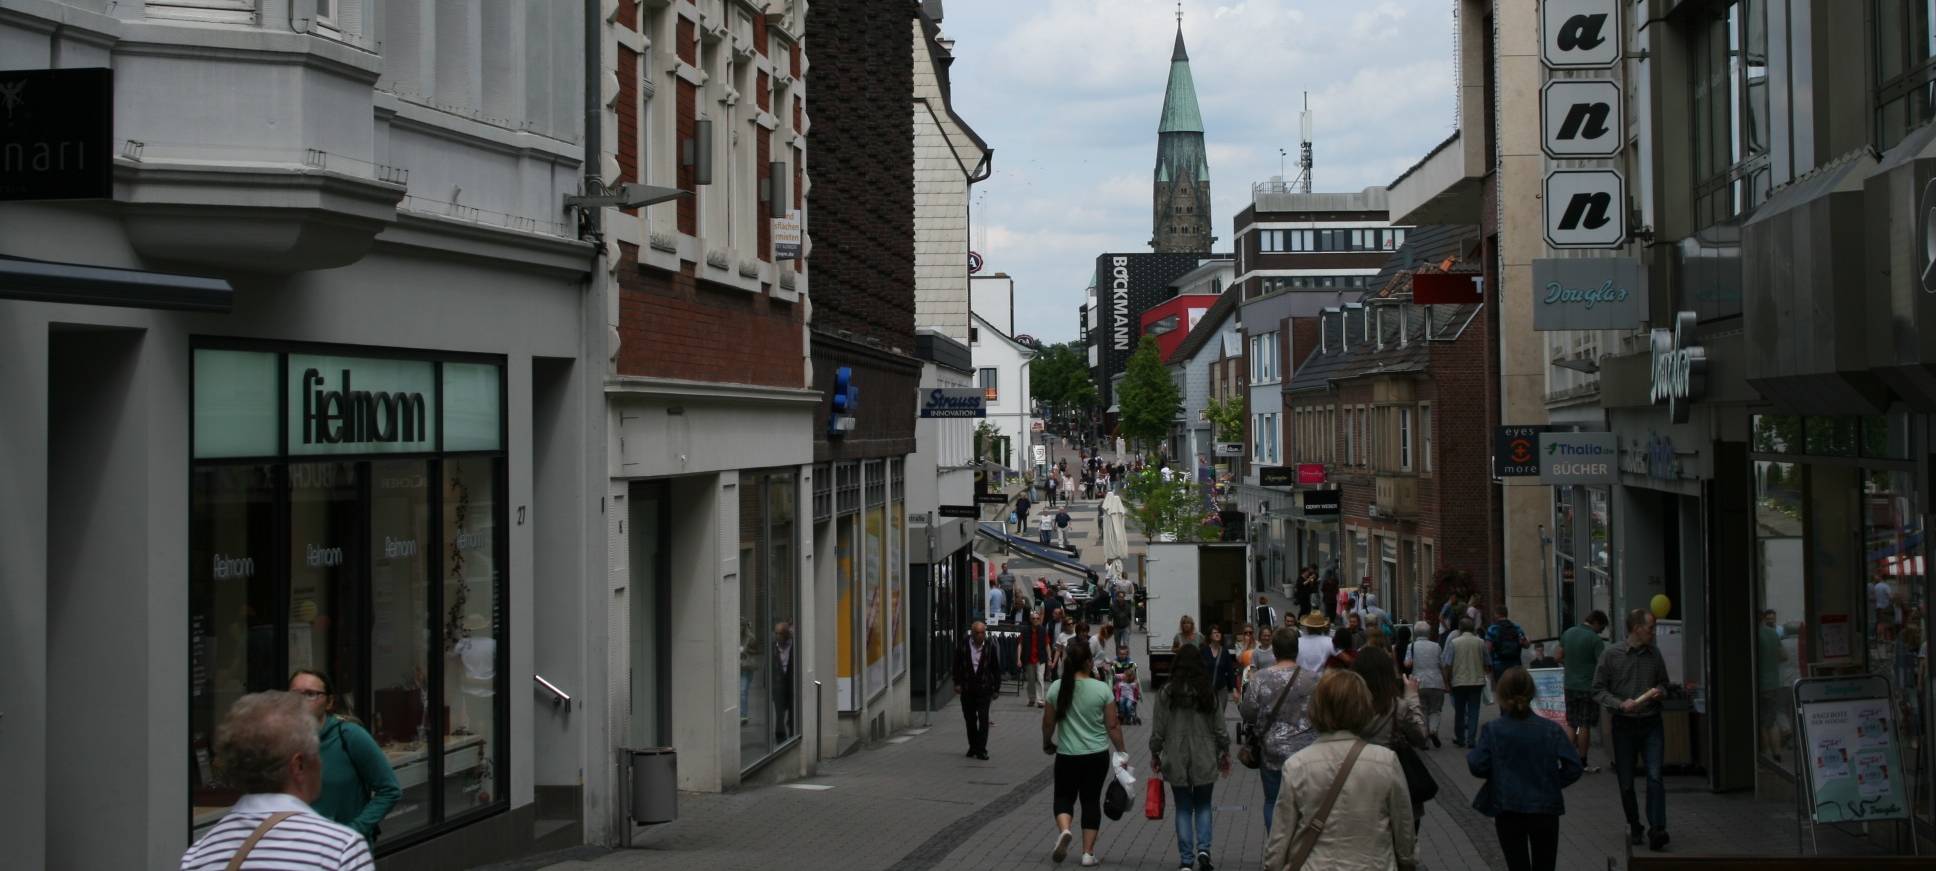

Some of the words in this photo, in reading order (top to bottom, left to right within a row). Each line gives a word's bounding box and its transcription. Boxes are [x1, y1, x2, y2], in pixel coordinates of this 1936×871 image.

[1113, 257, 1128, 350] BÖCKMANN
[1544, 280, 1629, 310] Douglas
[303, 368, 425, 444] fielmann
[926, 388, 981, 407] Strauss
[1504, 427, 1535, 436] eyes
[1504, 465, 1537, 474] more
[1552, 461, 1608, 476] BÜCHER
[517, 505, 526, 526] 27
